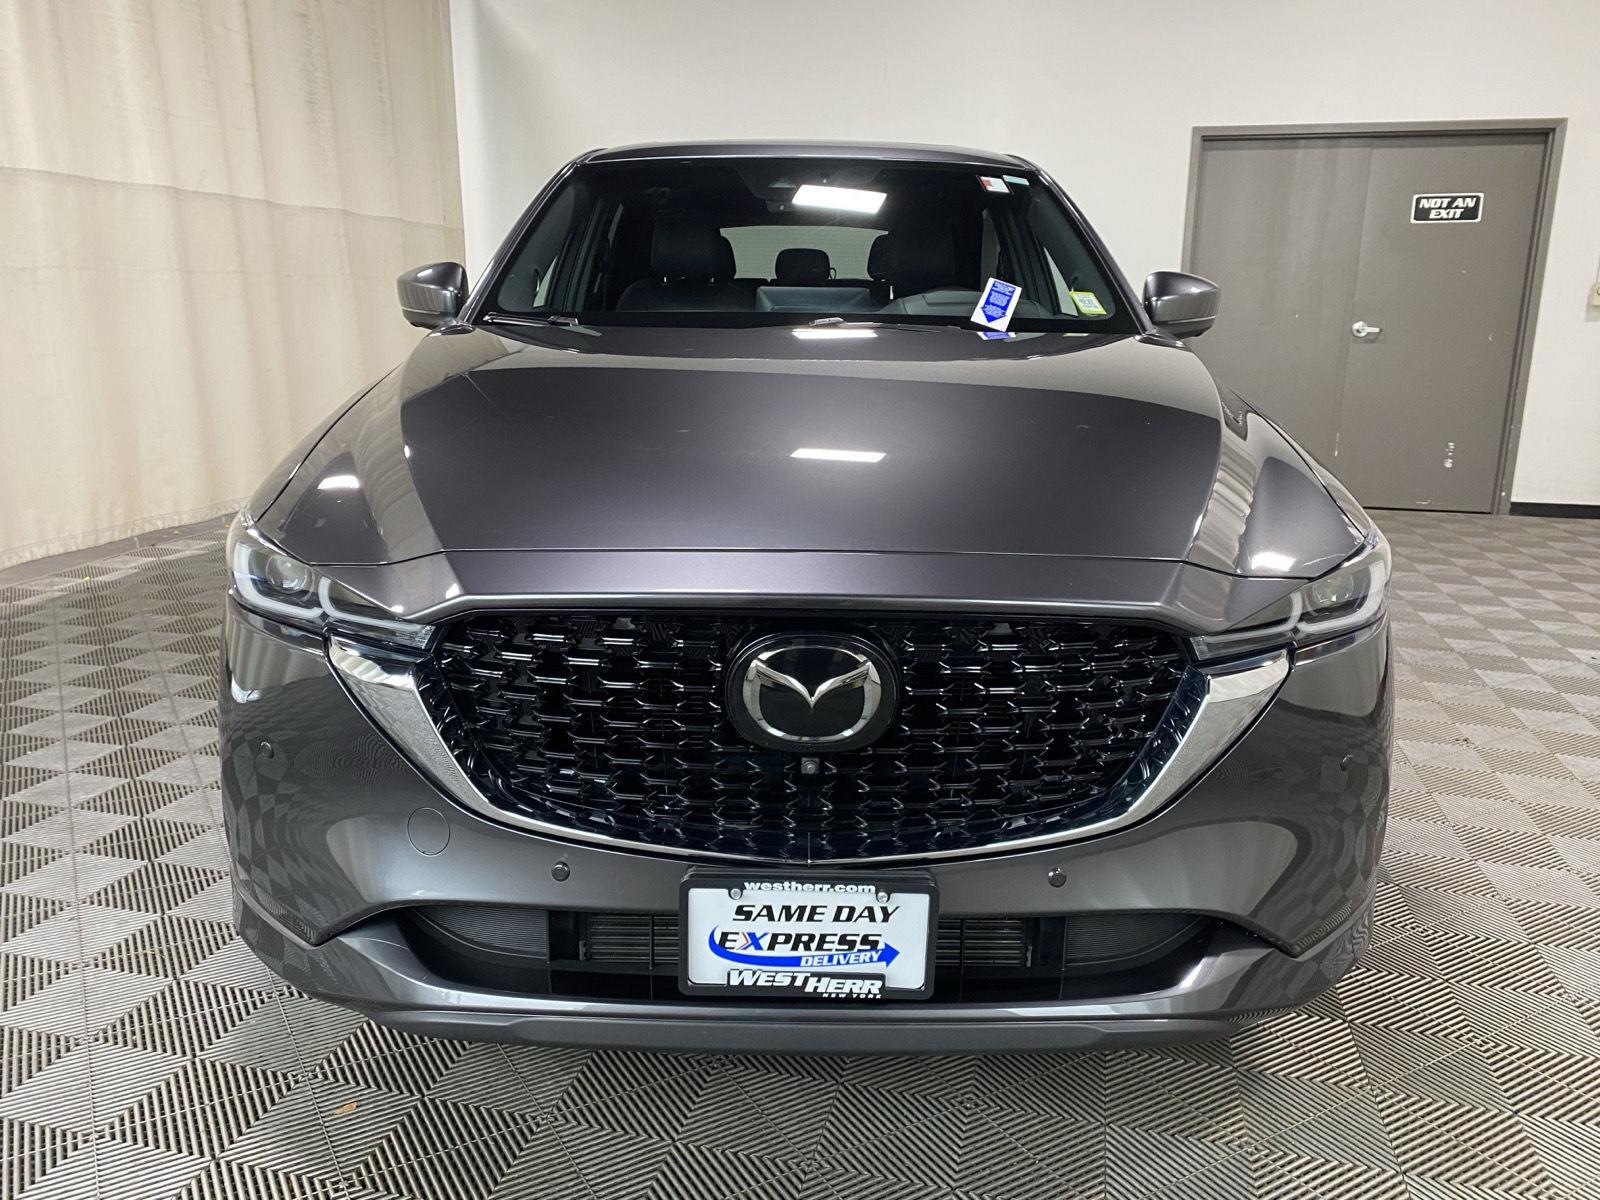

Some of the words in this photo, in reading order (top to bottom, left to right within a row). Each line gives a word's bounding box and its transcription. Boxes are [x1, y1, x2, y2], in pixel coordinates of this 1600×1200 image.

[1419, 198, 1451, 208] NOT
[1452, 198, 1476, 208] AN
[1429, 208, 1464, 219] EXIT
[743, 881, 876, 893] westherr.com
[733, 904, 827, 923] SAME
[832, 905, 901, 924] DAY
[718, 931, 883, 952] EXPRESS
[800, 951, 881, 967] DELIVERY
